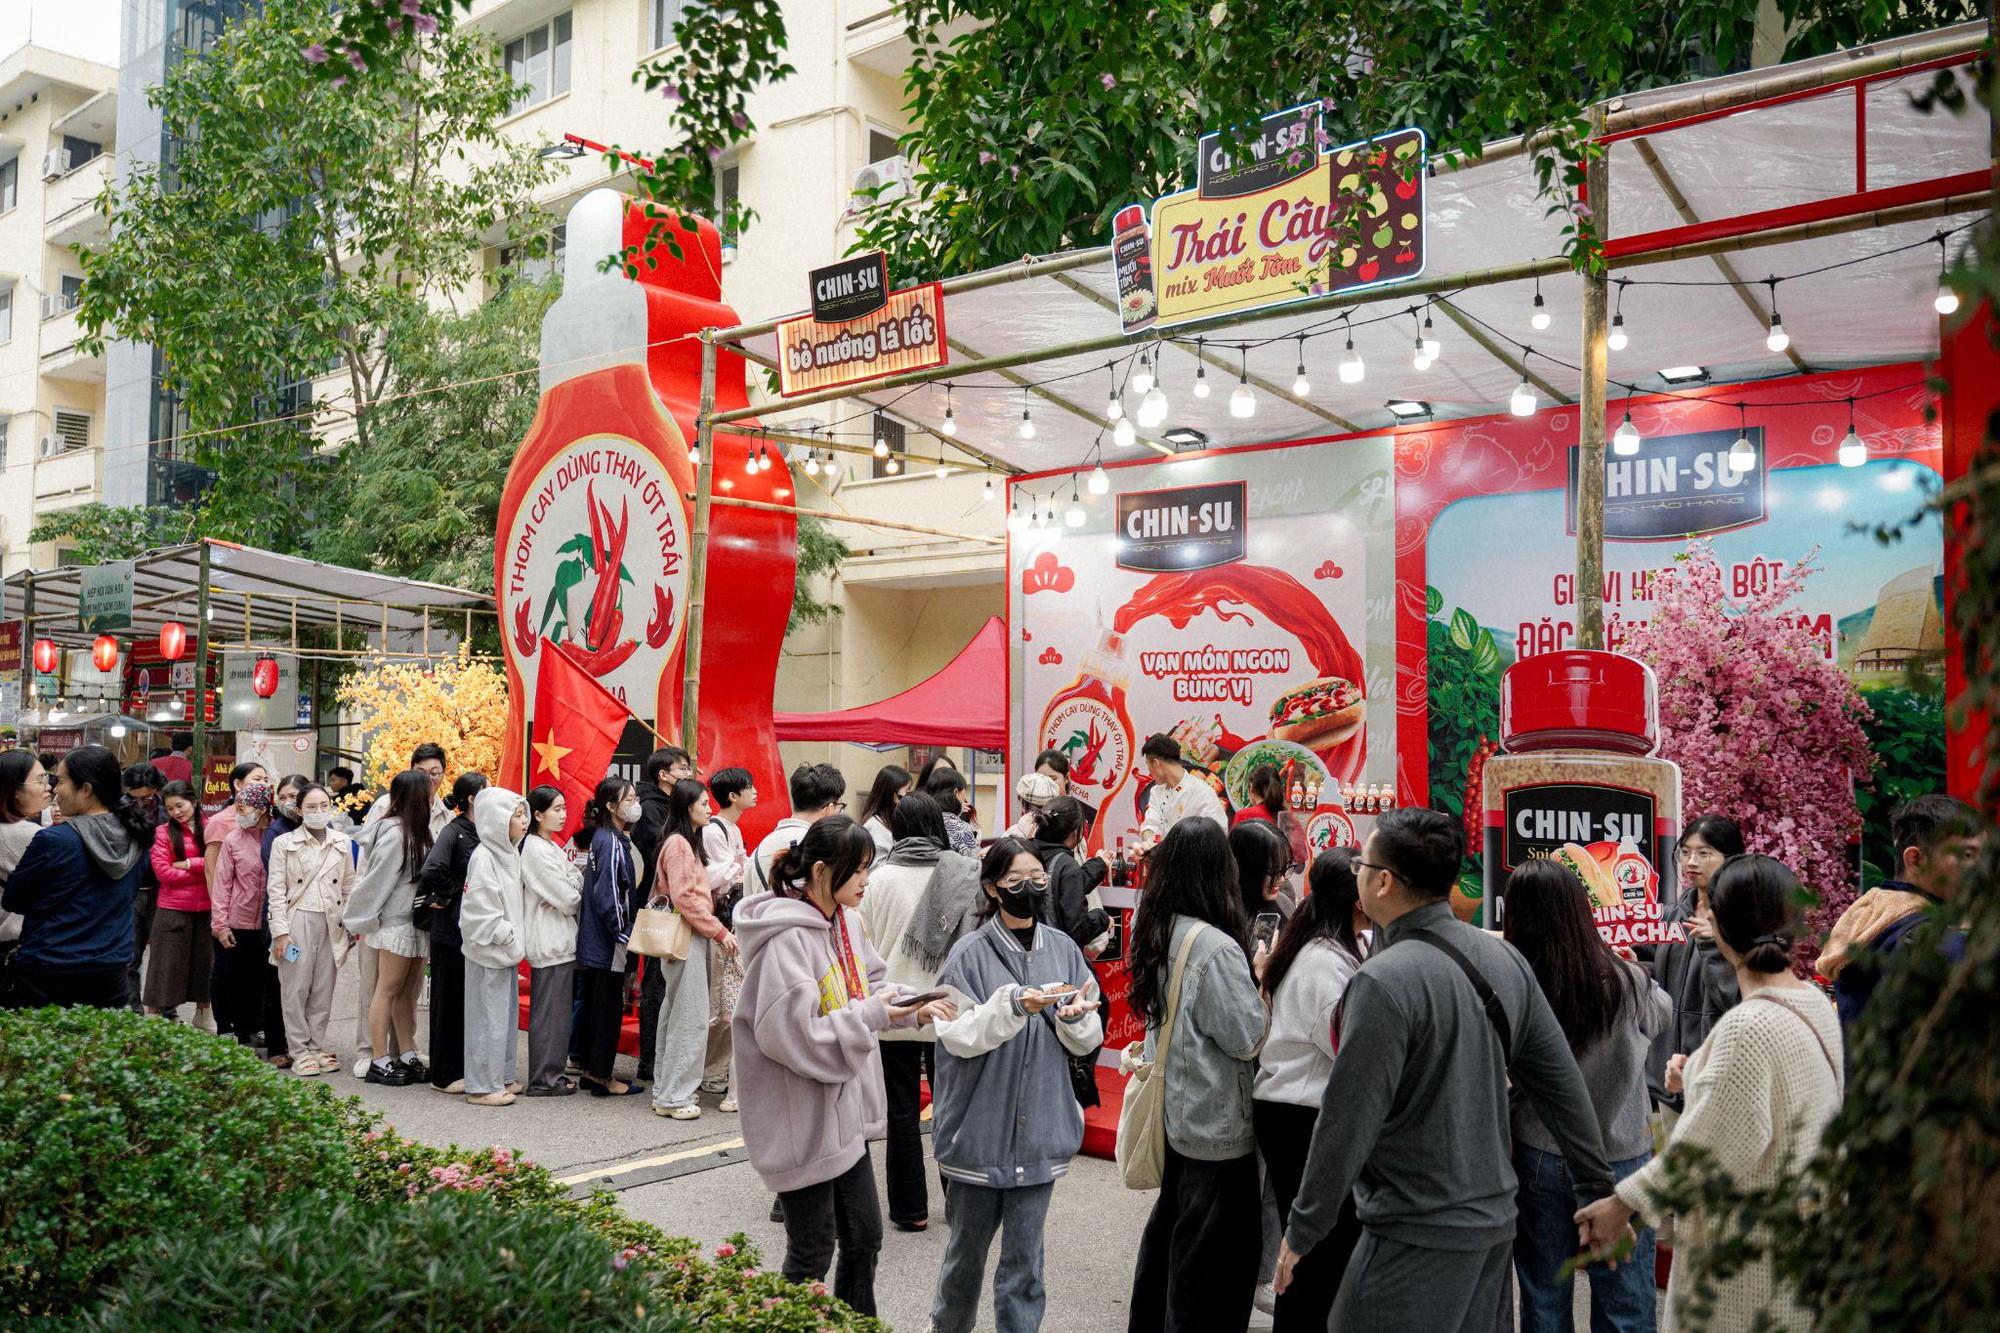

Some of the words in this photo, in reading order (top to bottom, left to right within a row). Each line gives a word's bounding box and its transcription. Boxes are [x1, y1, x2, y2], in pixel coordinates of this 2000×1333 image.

[1210, 126, 1306, 172] CN-SU
[1120, 238, 1145, 254] CHIN-SU
[1167, 212, 1247, 270] Trái
[1259, 196, 1340, 263] Cây
[817, 266, 878, 302] CHIN-SU
[1165, 275, 1199, 299] mix
[1203, 257, 1255, 293] Muối
[1258, 252, 1302, 281] Tôm
[789, 342, 813, 371] bò
[816, 332, 876, 365] nướng
[880, 320, 900, 351] lá
[902, 307, 933, 347] lốt
[1607, 451, 1744, 497] HIN-SU
[511, 524, 537, 596] THƠM
[531, 479, 556, 524] CAY
[556, 450, 601, 491] DÙNG
[605, 450, 647, 489] THAY
[642, 479, 666, 515] ỚT
[656, 512, 683, 576] TRÁI
[1127, 501, 1232, 539] CHIN-SU
[1554, 573, 1577, 605] GI
[1142, 653, 1180, 678] VẠN
[1184, 645, 1229, 672] MÓN
[1232, 650, 1289, 672] NGON
[1175, 675, 1228, 700] BÙNG
[1231, 679, 1251, 705] VỊ
[1065, 704, 1078, 717] CAY
[1100, 711, 1119, 732] THAY
[1070, 784, 1090, 800] ACHA
[1516, 808, 1643, 844] CHIN-SU
[1592, 903, 1663, 922] HIN-SU
[1597, 921, 1687, 944] RACHA
